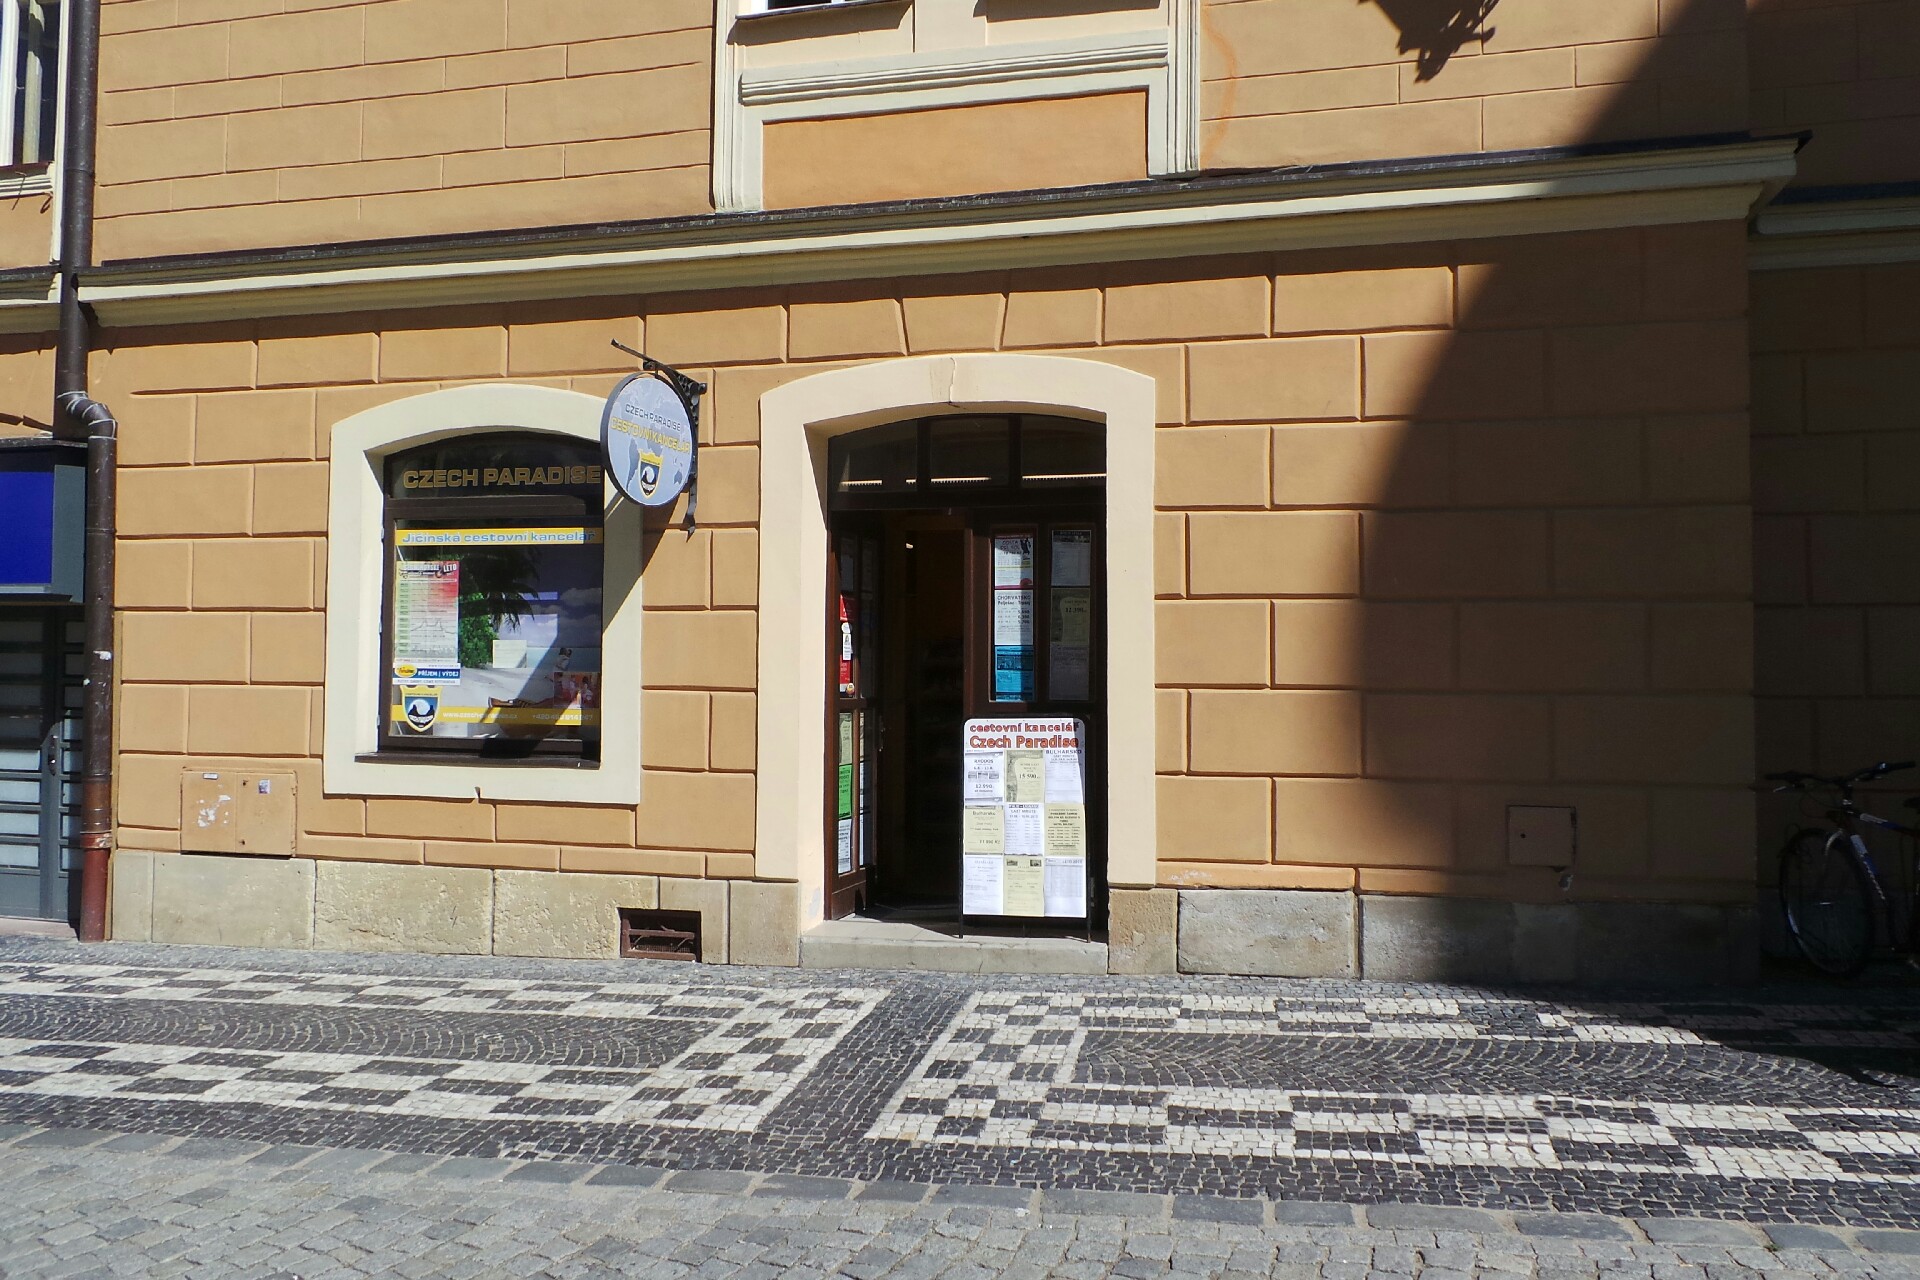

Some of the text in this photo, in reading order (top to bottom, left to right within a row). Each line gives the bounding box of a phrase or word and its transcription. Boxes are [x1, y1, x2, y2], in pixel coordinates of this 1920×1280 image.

[625, 403, 682, 432] CZECH PARADISE
[403, 466, 600, 489] CZECH PARADISE
[464, 531, 528, 543] cestovní
[970, 722, 1080, 732] cestovní kancelář
[970, 735, 1080, 748] Czech Paradise
